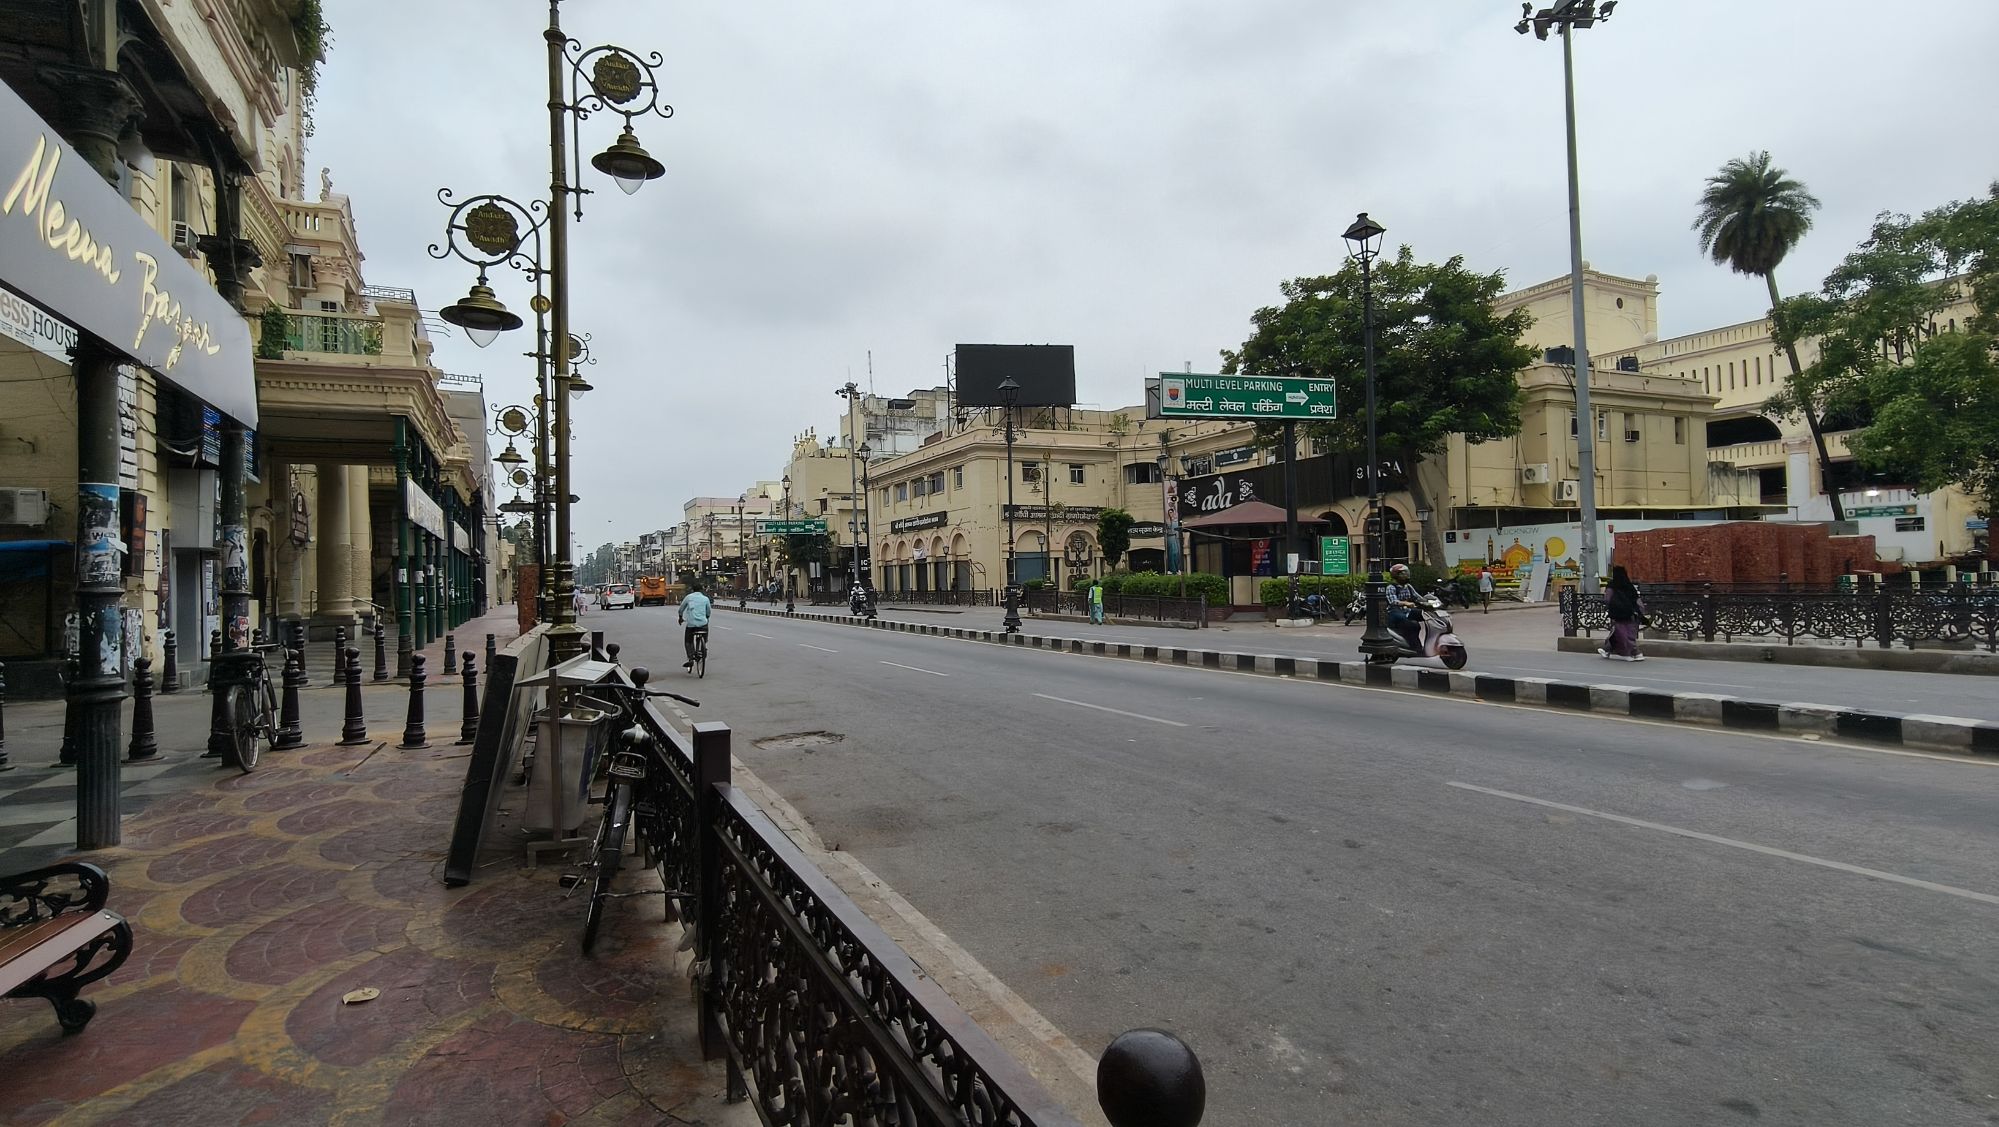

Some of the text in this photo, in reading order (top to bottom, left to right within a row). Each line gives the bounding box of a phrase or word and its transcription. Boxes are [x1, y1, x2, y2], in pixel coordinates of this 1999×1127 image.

[3, 132, 221, 370] Meena Bazaar
[1185, 378, 1334, 392] MULTI LEVEL PARKING ENTRY
[1186, 396, 1213, 411] मल्टी
[1219, 397, 1246, 412] लेवल
[1310, 401, 1333, 414] प्रवेश
[1201, 476, 1232, 511] ada
